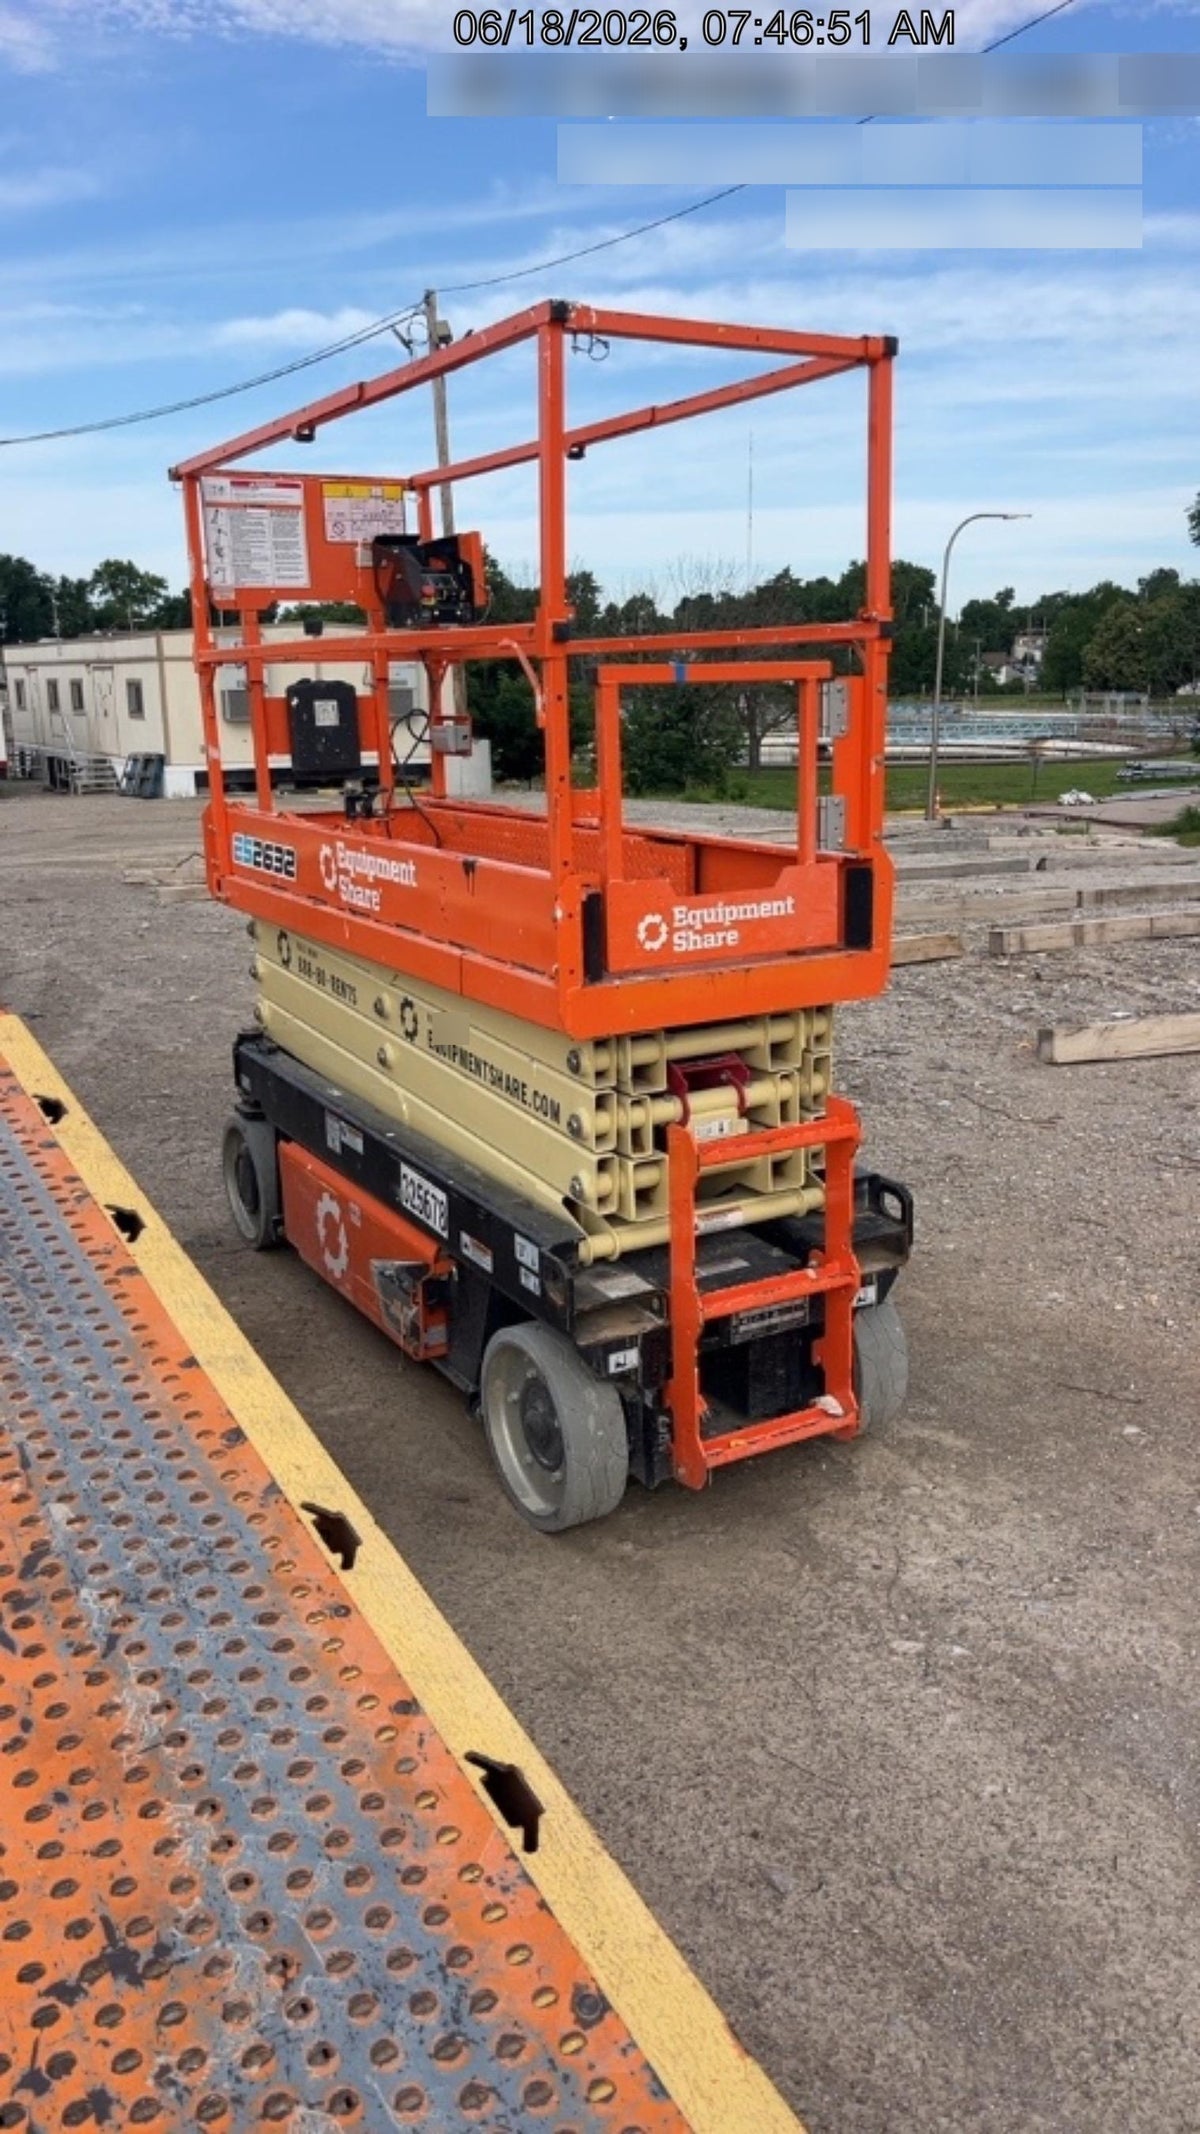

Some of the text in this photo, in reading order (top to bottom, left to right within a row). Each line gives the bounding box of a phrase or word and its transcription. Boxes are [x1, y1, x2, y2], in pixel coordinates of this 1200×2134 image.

[232, 833, 297, 879] ES2632
[336, 841, 417, 888] Equipment
[339, 874, 382, 911] Share
[673, 896, 795, 930] Equipment
[673, 930, 739, 952] Share
